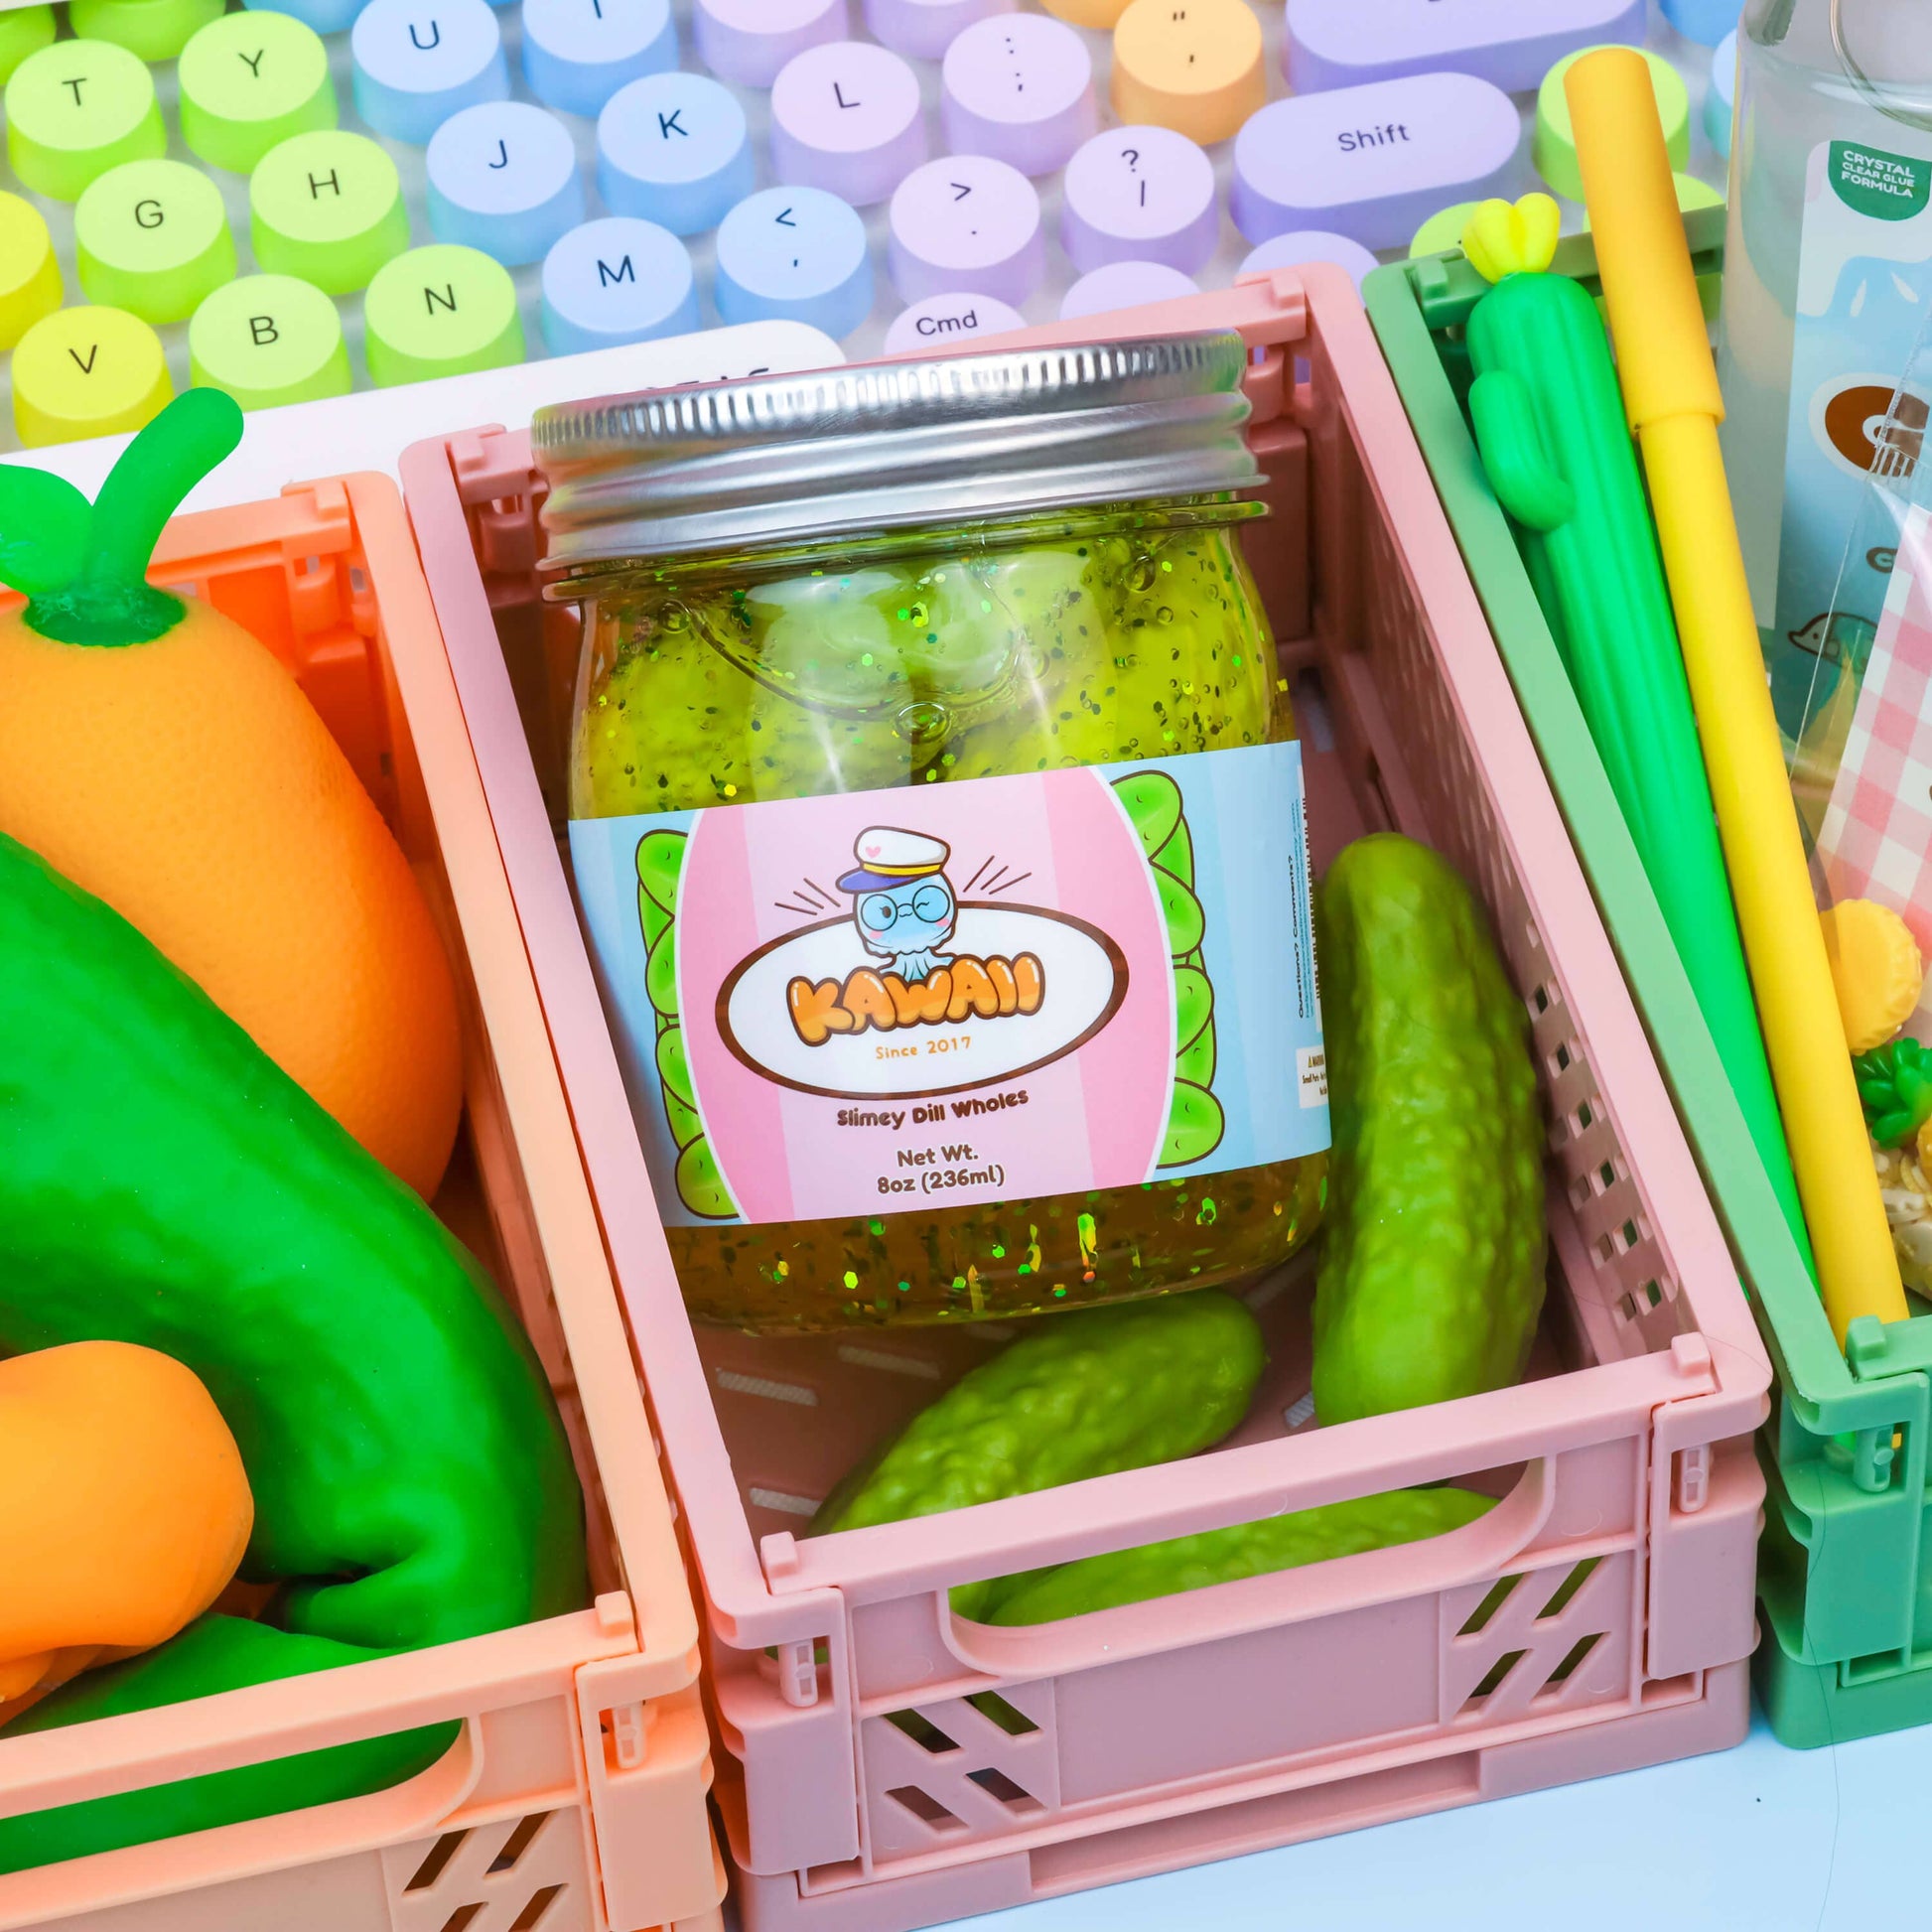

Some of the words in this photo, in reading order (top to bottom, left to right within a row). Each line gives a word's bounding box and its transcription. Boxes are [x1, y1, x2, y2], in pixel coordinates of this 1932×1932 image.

[409, 20, 440, 50] U
[238, 49, 264, 77] Y
[62, 77, 87, 106] T
[833, 81, 861, 109] L
[658, 109, 688, 140] K
[1337, 123, 1410, 152] Shift
[488, 139, 508, 169] J
[1121, 149, 1140, 173] ?
[1843, 150, 1915, 178] CRYSTAL
[308, 169, 341, 200] H
[1841, 171, 1914, 199] FORMULA
[1842, 162, 1880, 179] CLEAR
[1882, 174, 1915, 187] GLUE
[950, 182, 972, 202] >
[134, 200, 164, 229] G
[774, 207, 796, 227] <
[597, 254, 635, 288] M
[424, 284, 457, 316] N
[249, 316, 279, 345] B
[915, 310, 978, 336] Cmd
[69, 344, 97, 374] V
[1288, 856, 1299, 938] Comments?
[1294, 943, 1304, 1019] Questions?
[786, 951, 1045, 1047] KAWAII
[875, 1045, 918, 1060] Since
[926, 1035, 972, 1054] 2017
[837, 1107, 906, 1131] Slimey
[911, 1103, 946, 1124] Dill
[950, 1089, 1030, 1118] Wholes
[897, 1148, 936, 1168] Net
[940, 1144, 979, 1163] Wt.
[877, 1175, 916, 1194] 8oz
[921, 1164, 1006, 1194] (236ml)
